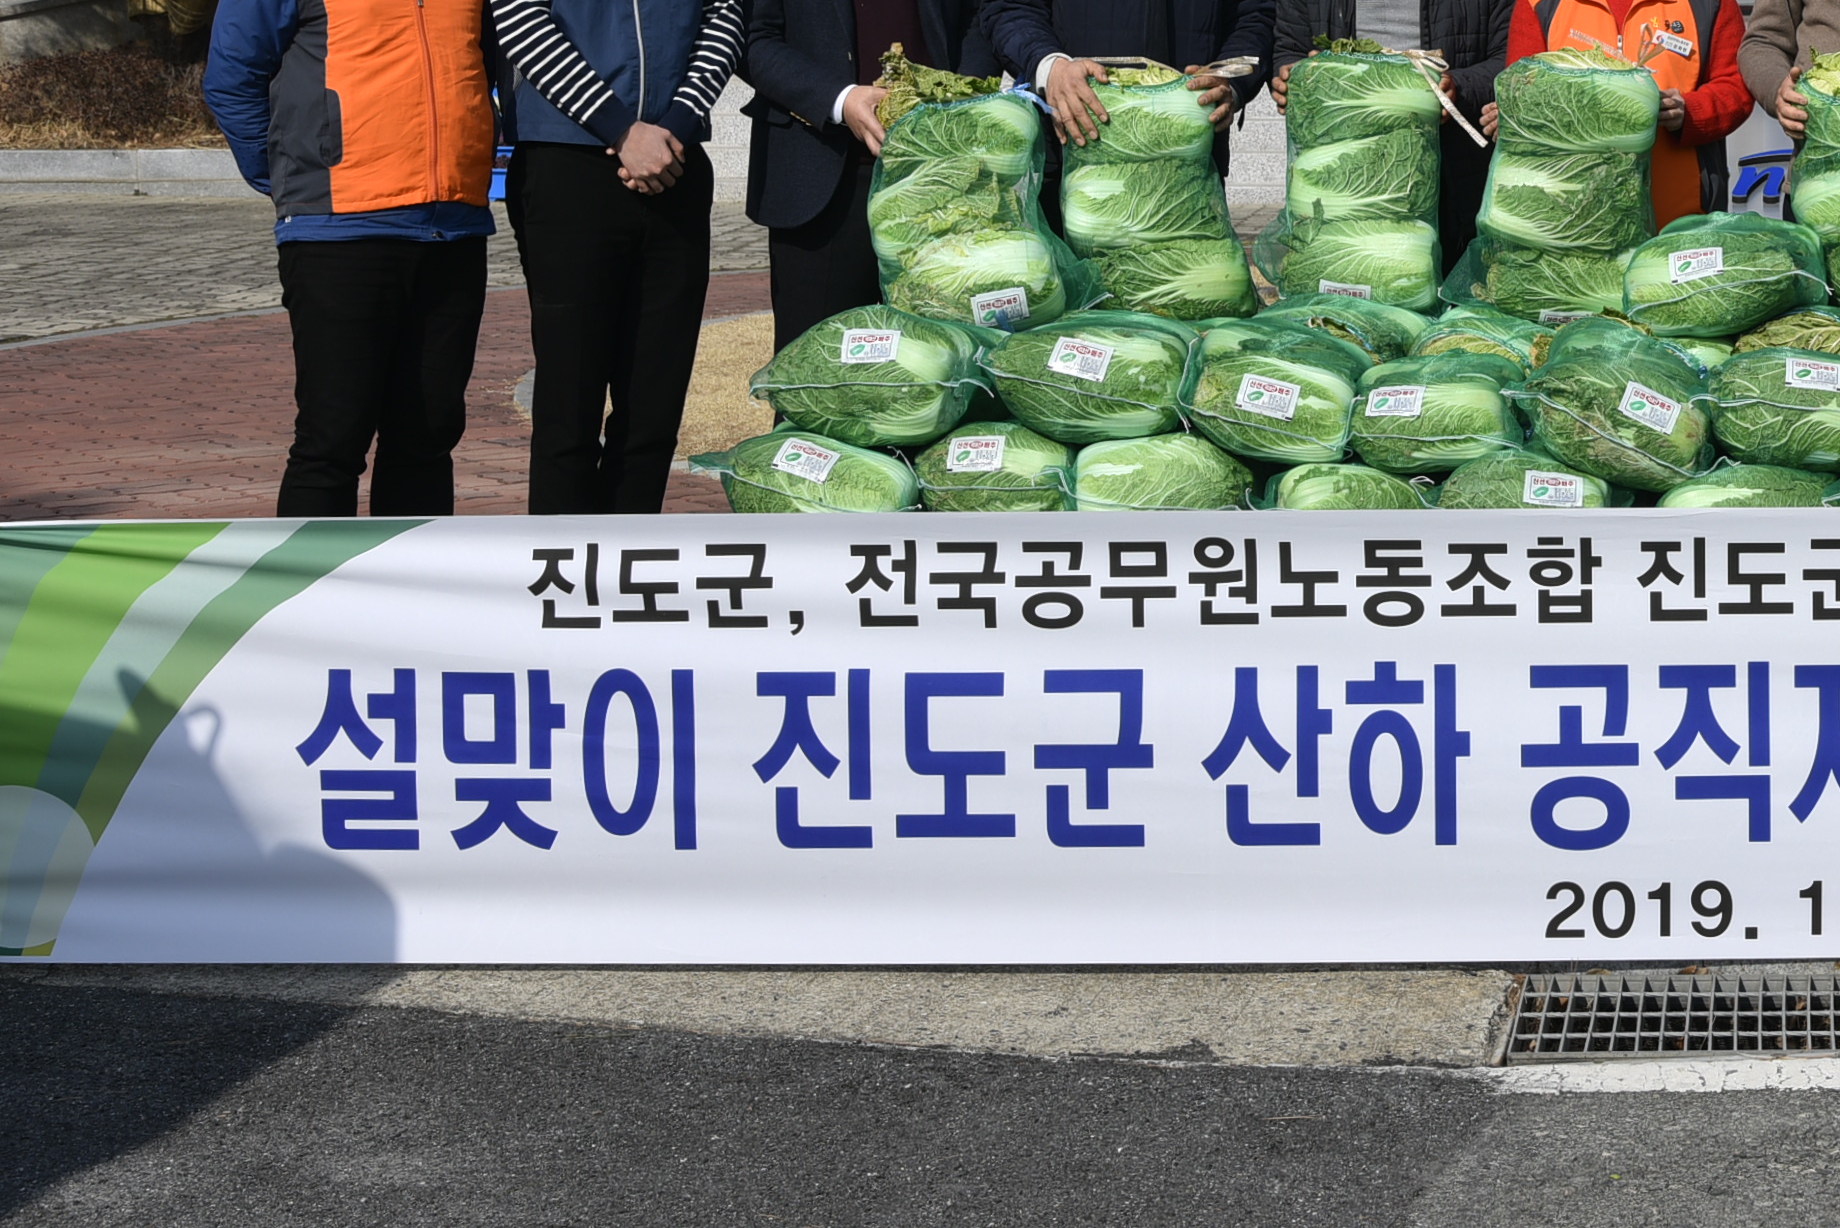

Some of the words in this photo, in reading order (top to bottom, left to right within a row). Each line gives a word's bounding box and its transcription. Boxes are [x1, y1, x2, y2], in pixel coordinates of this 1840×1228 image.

[528, 544, 804, 635] 진도군,
[846, 537, 1601, 629] 전국공무원노동조합
[295, 668, 697, 851] 설맞이
[752, 669, 1154, 849] 진도군
[1202, 661, 1470, 847] 산하
[1546, 881, 1758, 940] 2019.
